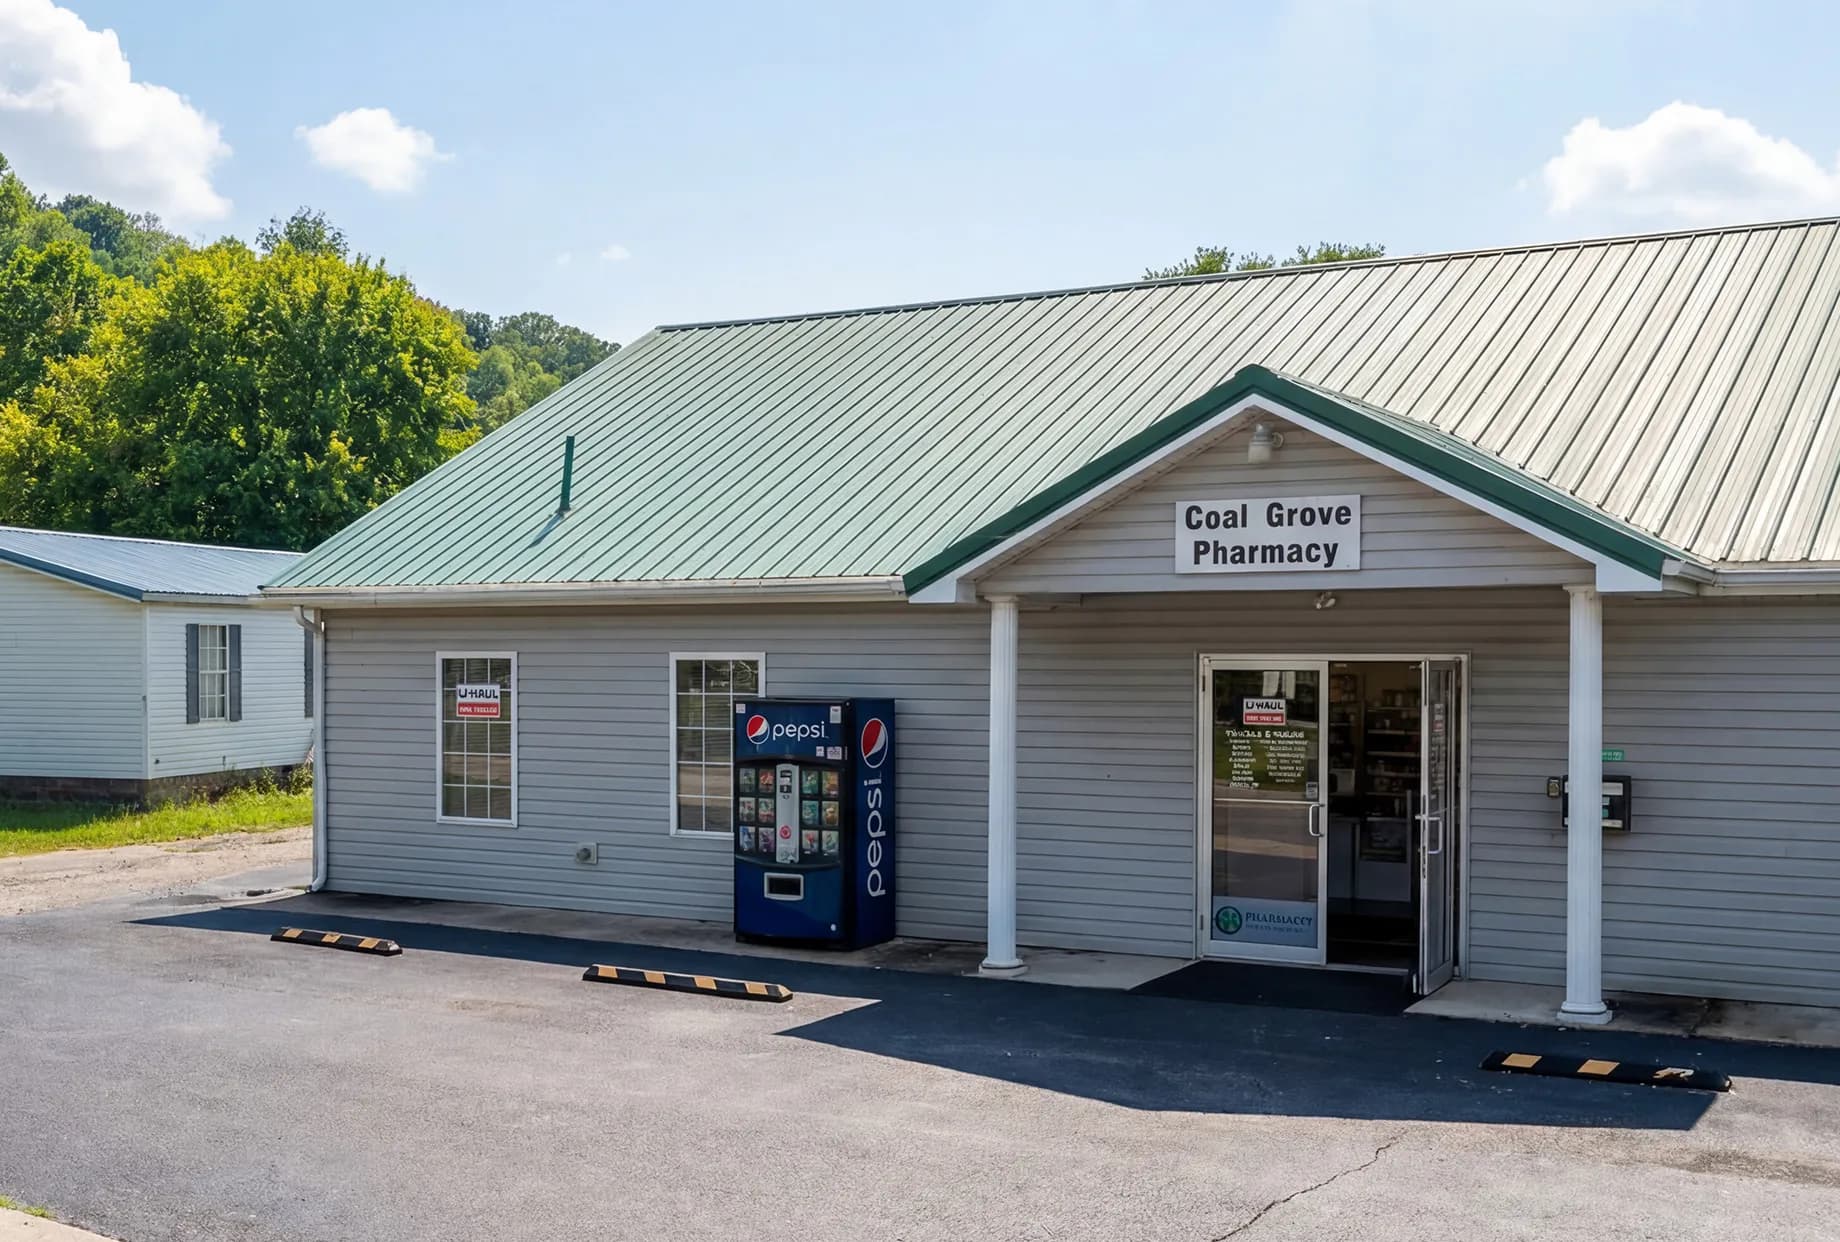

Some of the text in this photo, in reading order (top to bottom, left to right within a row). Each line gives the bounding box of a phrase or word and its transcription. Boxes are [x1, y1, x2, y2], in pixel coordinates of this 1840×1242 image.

[1185, 502, 1352, 530] Coal Grove
[1193, 540, 1339, 568] Pharmacy
[458, 688, 499, 699] U-HAUL
[772, 720, 825, 742] pepsi
[863, 778, 887, 897] pepsi
